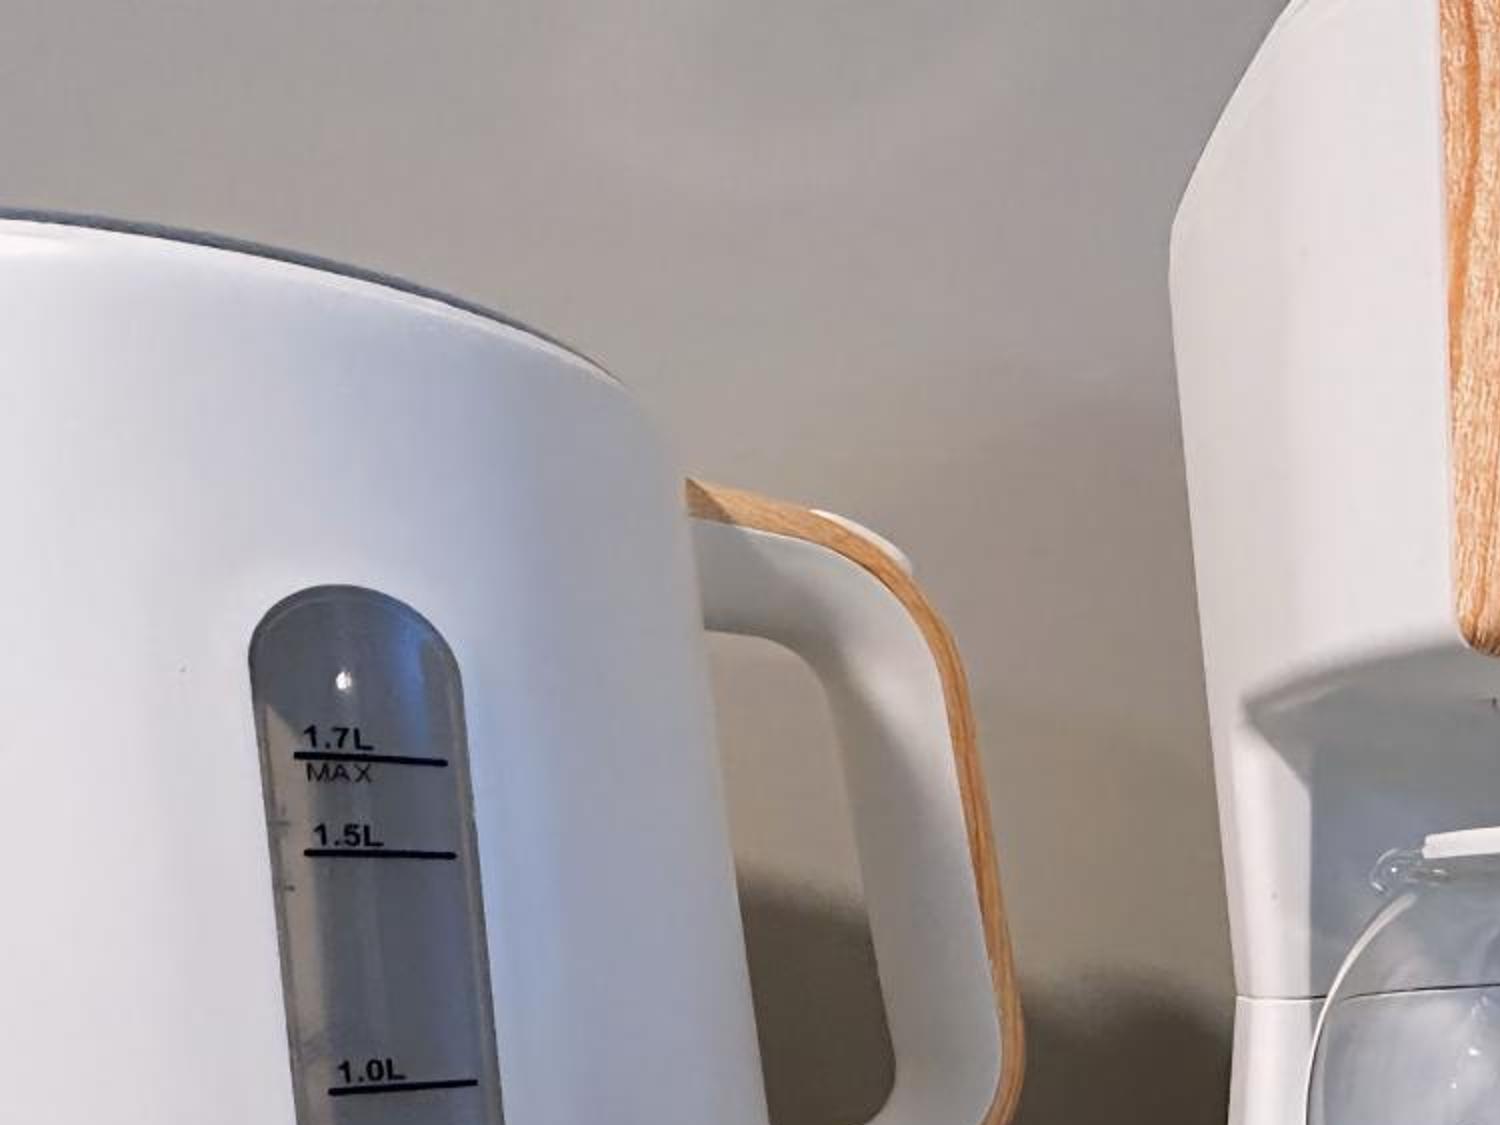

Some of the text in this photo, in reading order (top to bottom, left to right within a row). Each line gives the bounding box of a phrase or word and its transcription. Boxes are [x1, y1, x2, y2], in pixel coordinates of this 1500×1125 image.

[304, 724, 374, 750] 1.7L
[306, 762, 372, 783] MAX
[313, 822, 385, 847] 1.5L
[338, 1058, 406, 1084] 1.0L
